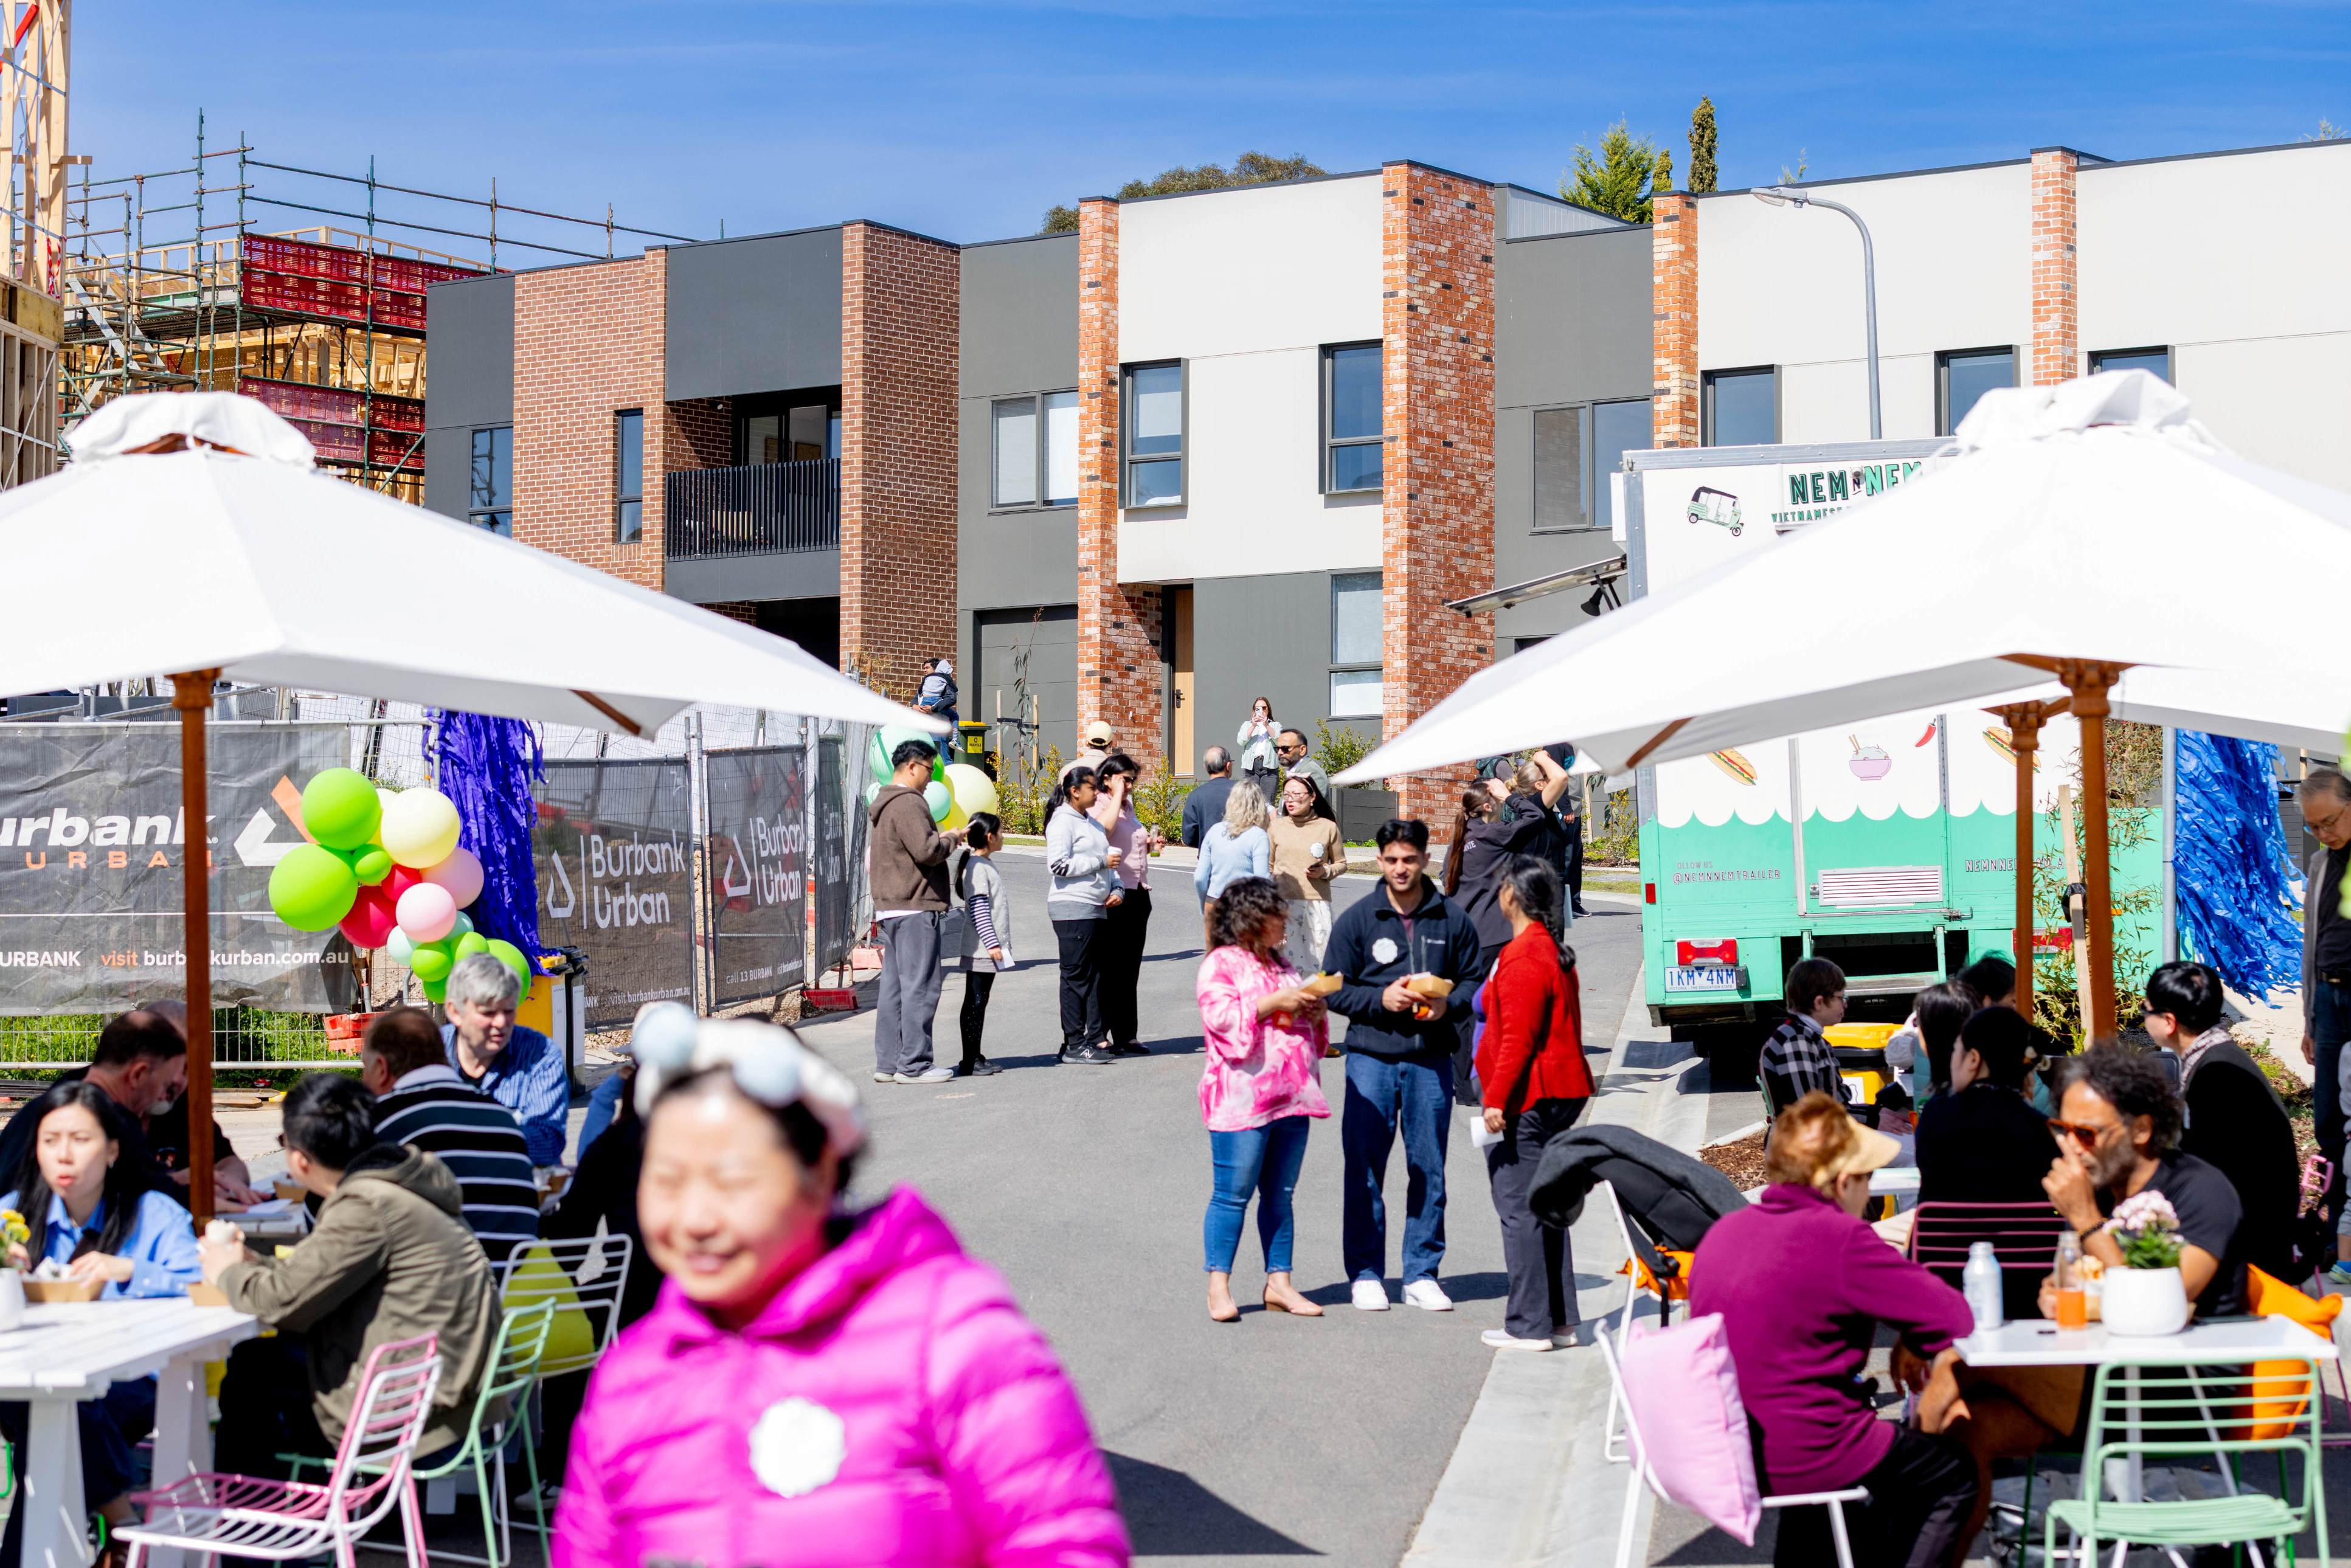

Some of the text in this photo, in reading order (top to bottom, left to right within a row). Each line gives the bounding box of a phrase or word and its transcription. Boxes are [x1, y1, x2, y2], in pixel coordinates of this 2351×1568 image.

[1789, 470, 1849, 505] NEM
[757, 811, 805, 857] Burbank
[26, 851, 212, 869] URBA
[591, 829, 686, 878] Burbank
[762, 860, 801, 905] Urban
[1673, 869, 1781, 885] @NEMNNEMTRAILER
[594, 882, 670, 929] Urban
[101, 950, 138, 966] visit
[144, 950, 349, 966] burbkurban.com.au
[726, 971, 738, 984] call
[741, 970, 748, 982] 13
[749, 965, 772, 981] BURBANK
[1669, 969, 1734, 986] 1KM 4NM
[609, 992, 626, 1005] visit
[627, 986, 691, 1003] burbankurban.com.au
